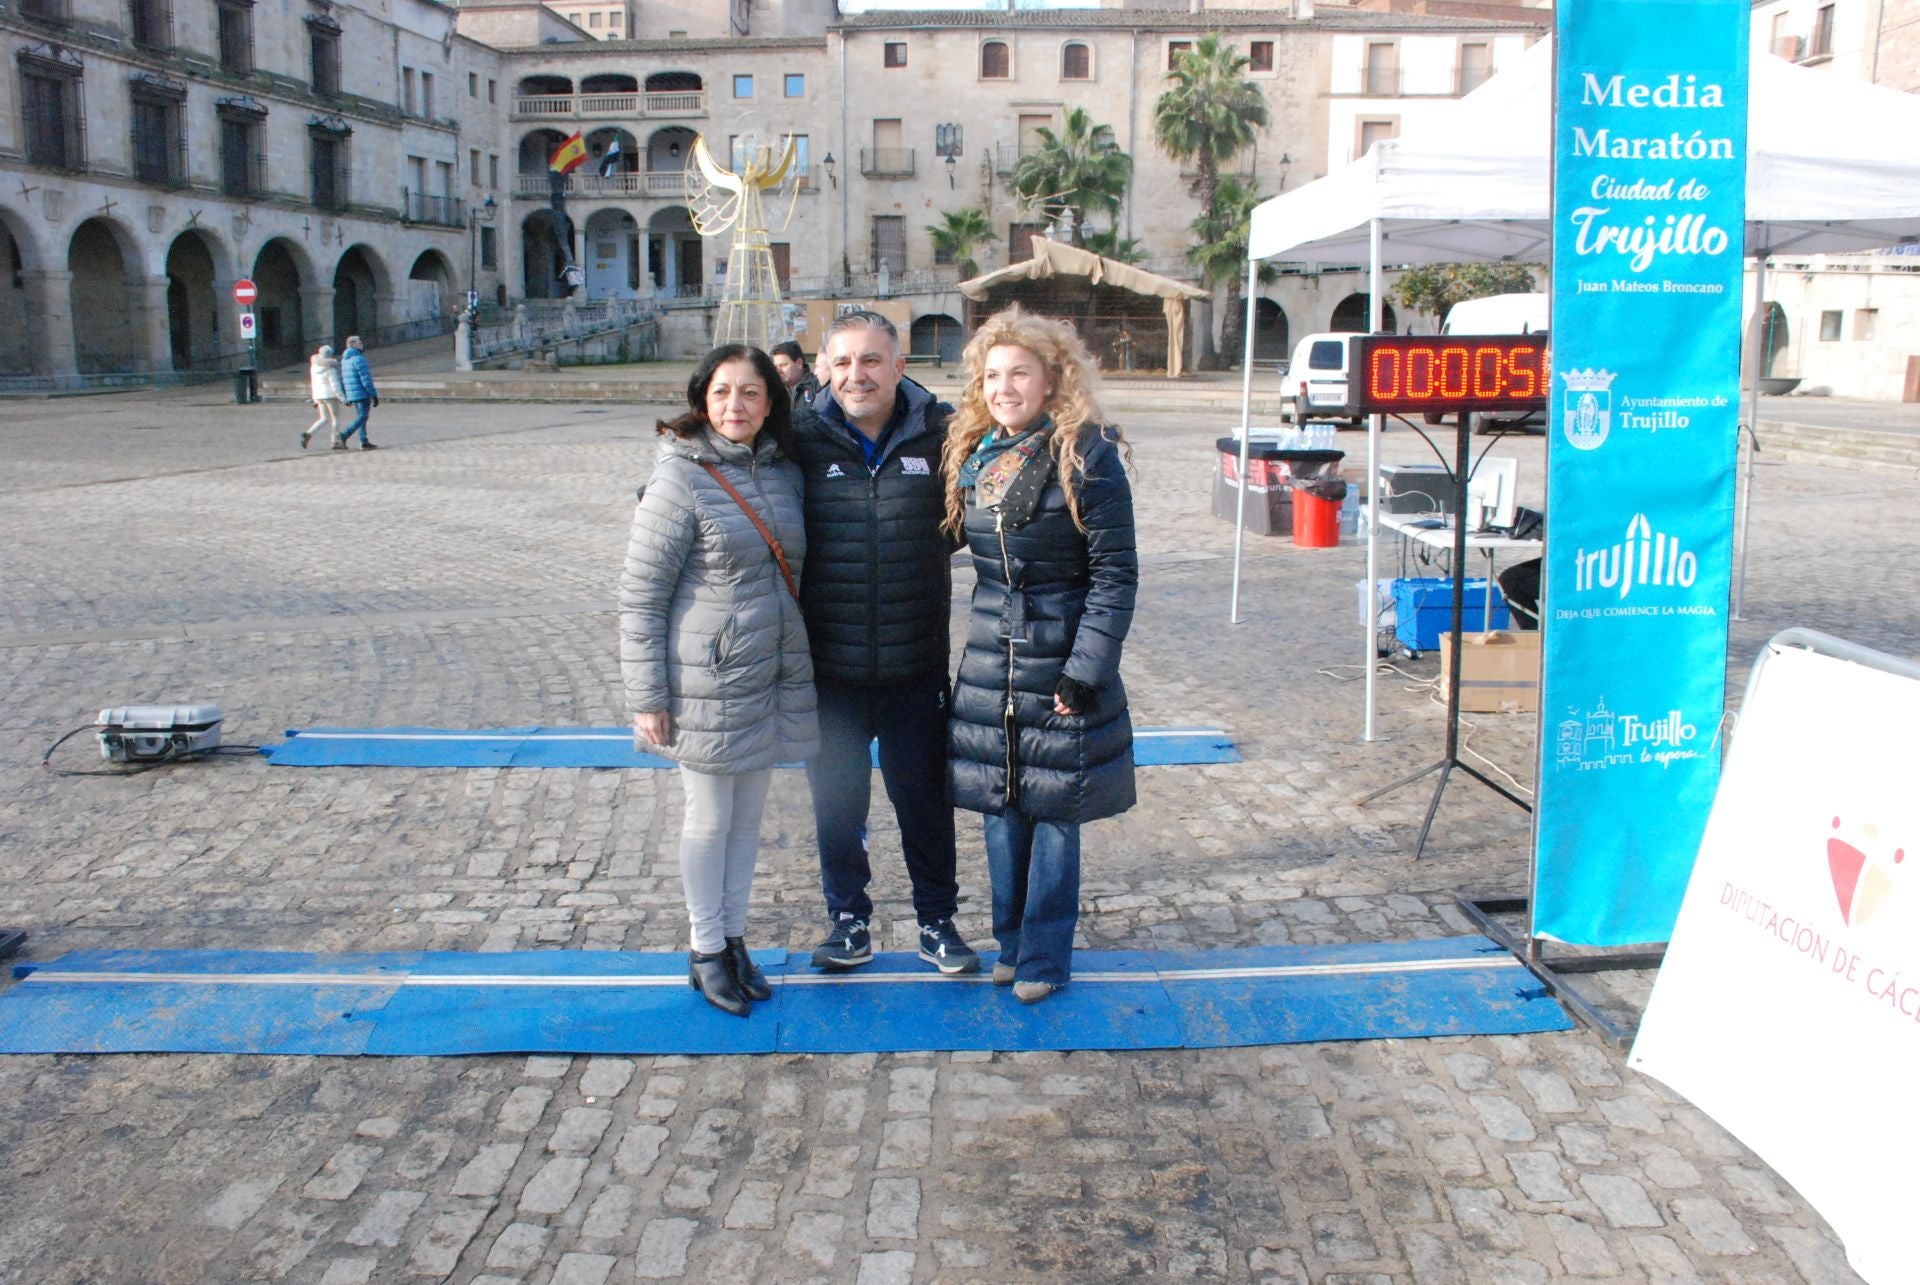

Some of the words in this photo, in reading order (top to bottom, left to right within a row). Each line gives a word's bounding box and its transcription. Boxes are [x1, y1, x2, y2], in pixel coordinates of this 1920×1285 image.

[1581, 72, 1725, 108] Media
[1572, 126, 1735, 160] Maratón
[1591, 174, 1674, 200] Ciudad
[1677, 178, 1710, 200] de
[1570, 206, 1728, 273] Trujillo
[1577, 280, 1608, 295] Juan
[1611, 279, 1659, 293] Mateos
[1662, 280, 1724, 294] Broncano
[1620, 395, 1709, 410] Ayuntamiento
[1711, 394, 1729, 407] de
[1619, 411, 1690, 433] Trujillo
[1575, 512, 1697, 600] trujillo
[1556, 609, 1579, 620] DEJA
[1581, 607, 1601, 618] QUE
[1603, 606, 1659, 617] COMIENCE
[1662, 605, 1674, 615] LA
[1677, 605, 1715, 616] MAGIA
[1618, 709, 1697, 747] Trujillo
[1640, 746, 1653, 763] te
[1720, 881, 1830, 963] DIPUTACIÓN
[1832, 946, 1861, 982] DE
